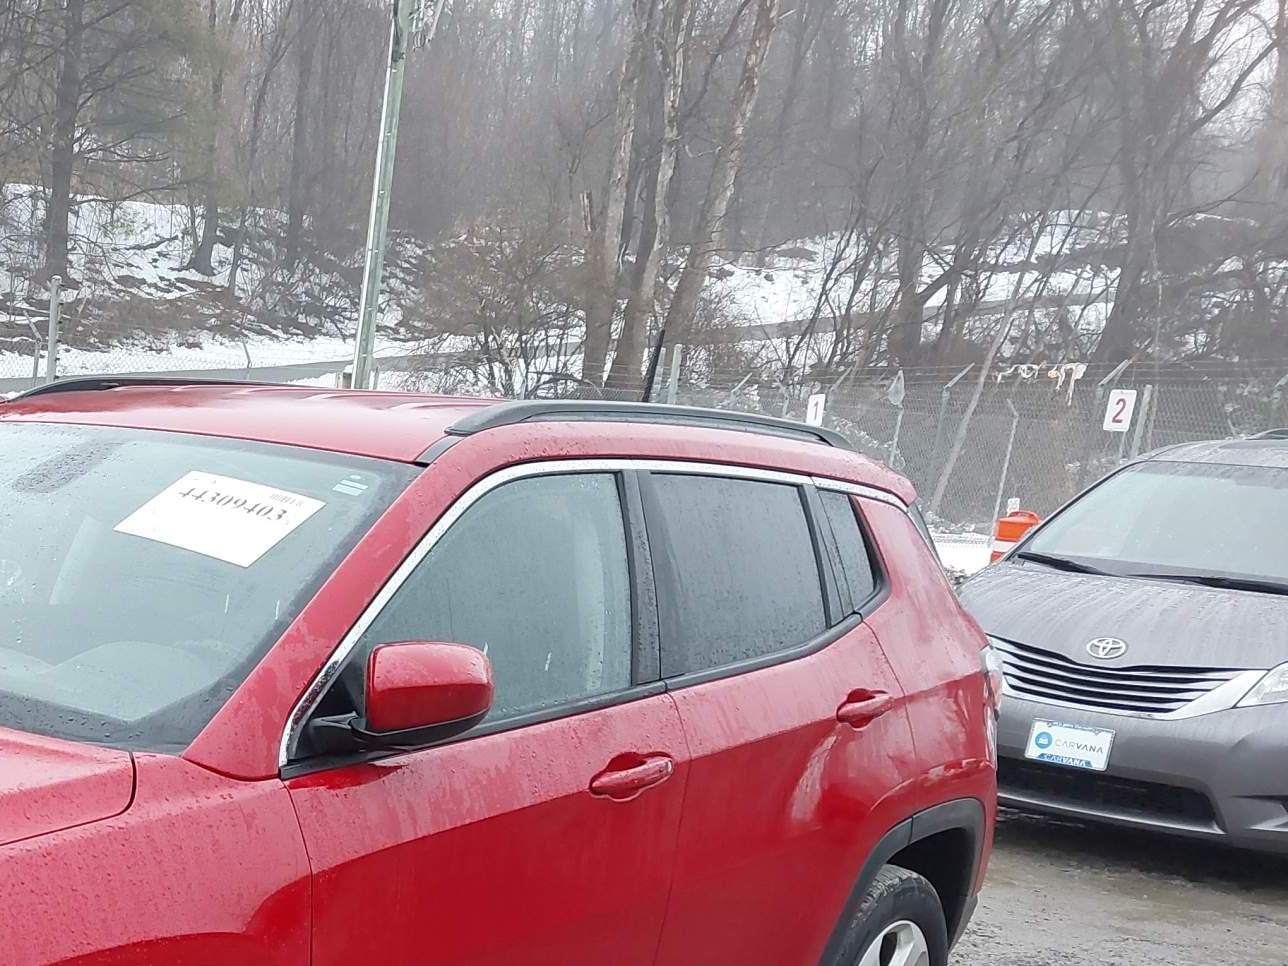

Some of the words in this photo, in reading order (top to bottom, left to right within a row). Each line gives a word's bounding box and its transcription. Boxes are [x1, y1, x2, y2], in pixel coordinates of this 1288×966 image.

[814, 400, 819, 421] 1
[1111, 398, 1127, 424] 2
[178, 487, 288, 521] 44309403
[1055, 738, 1104, 755] CARVANA
